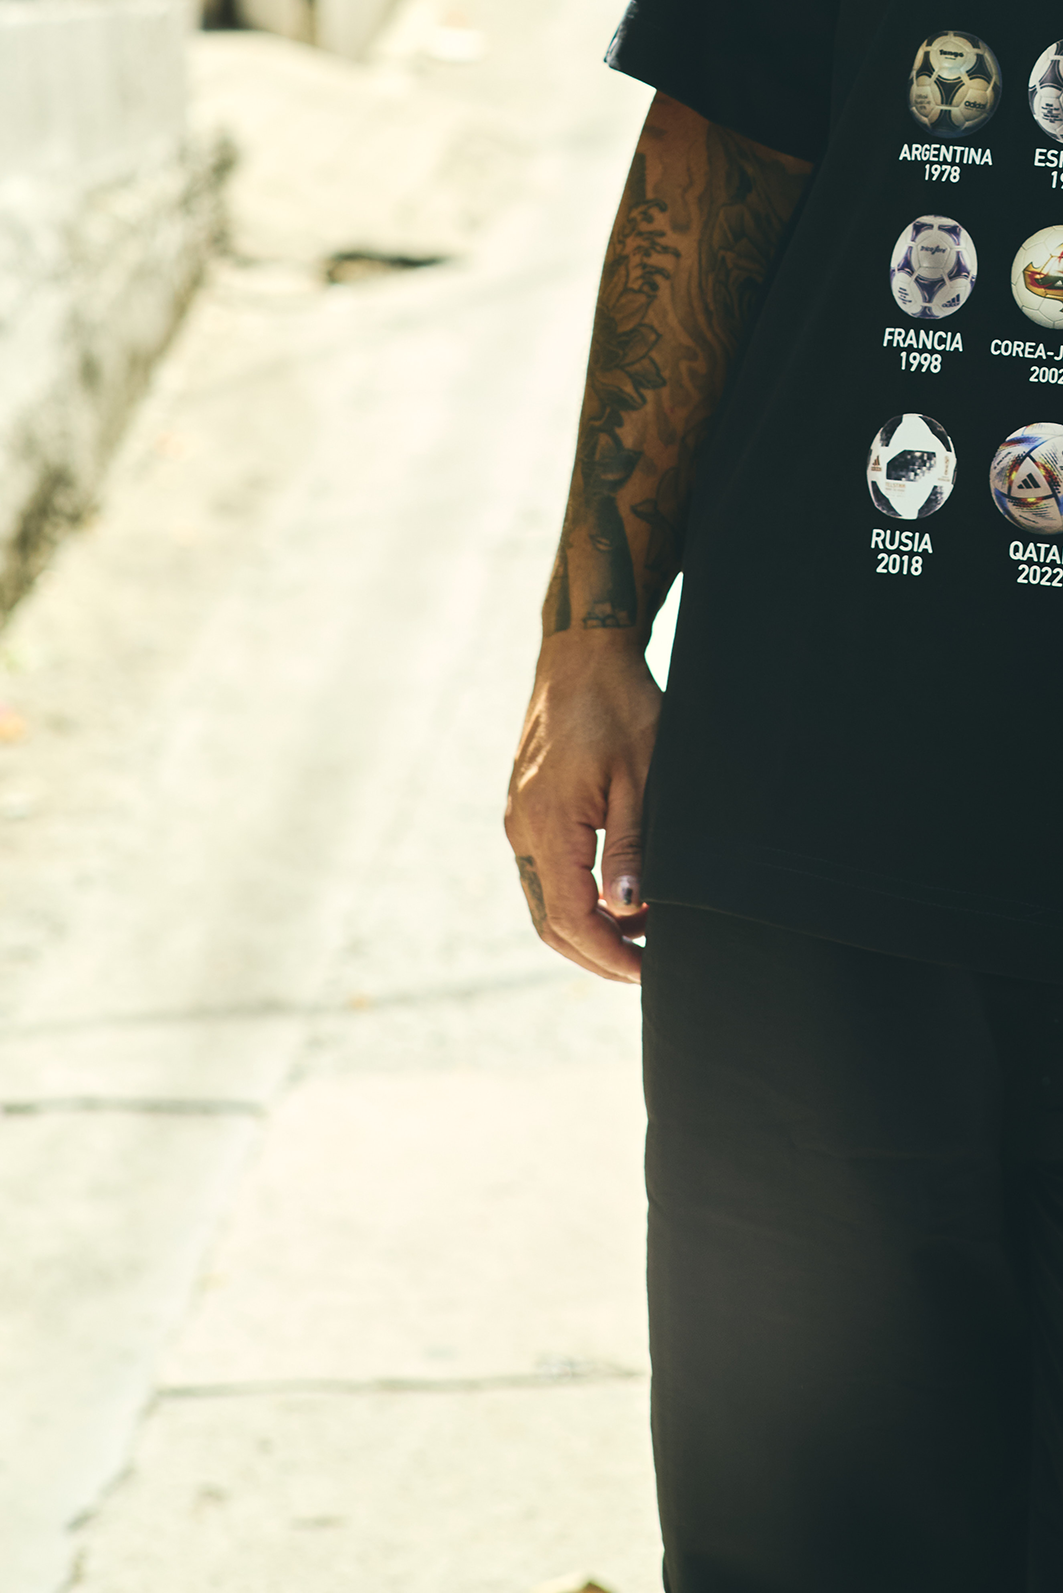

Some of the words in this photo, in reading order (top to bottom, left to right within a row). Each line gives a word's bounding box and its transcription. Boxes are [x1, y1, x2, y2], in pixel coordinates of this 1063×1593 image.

[898, 143, 993, 166] ARGENTINA
[924, 163, 961, 183] 1978
[882, 327, 964, 352] FRANCIA
[900, 351, 942, 374] 1998
[870, 528, 933, 554] RUSIA
[875, 552, 923, 576] 2018
[1016, 563, 1063, 588] 2022
